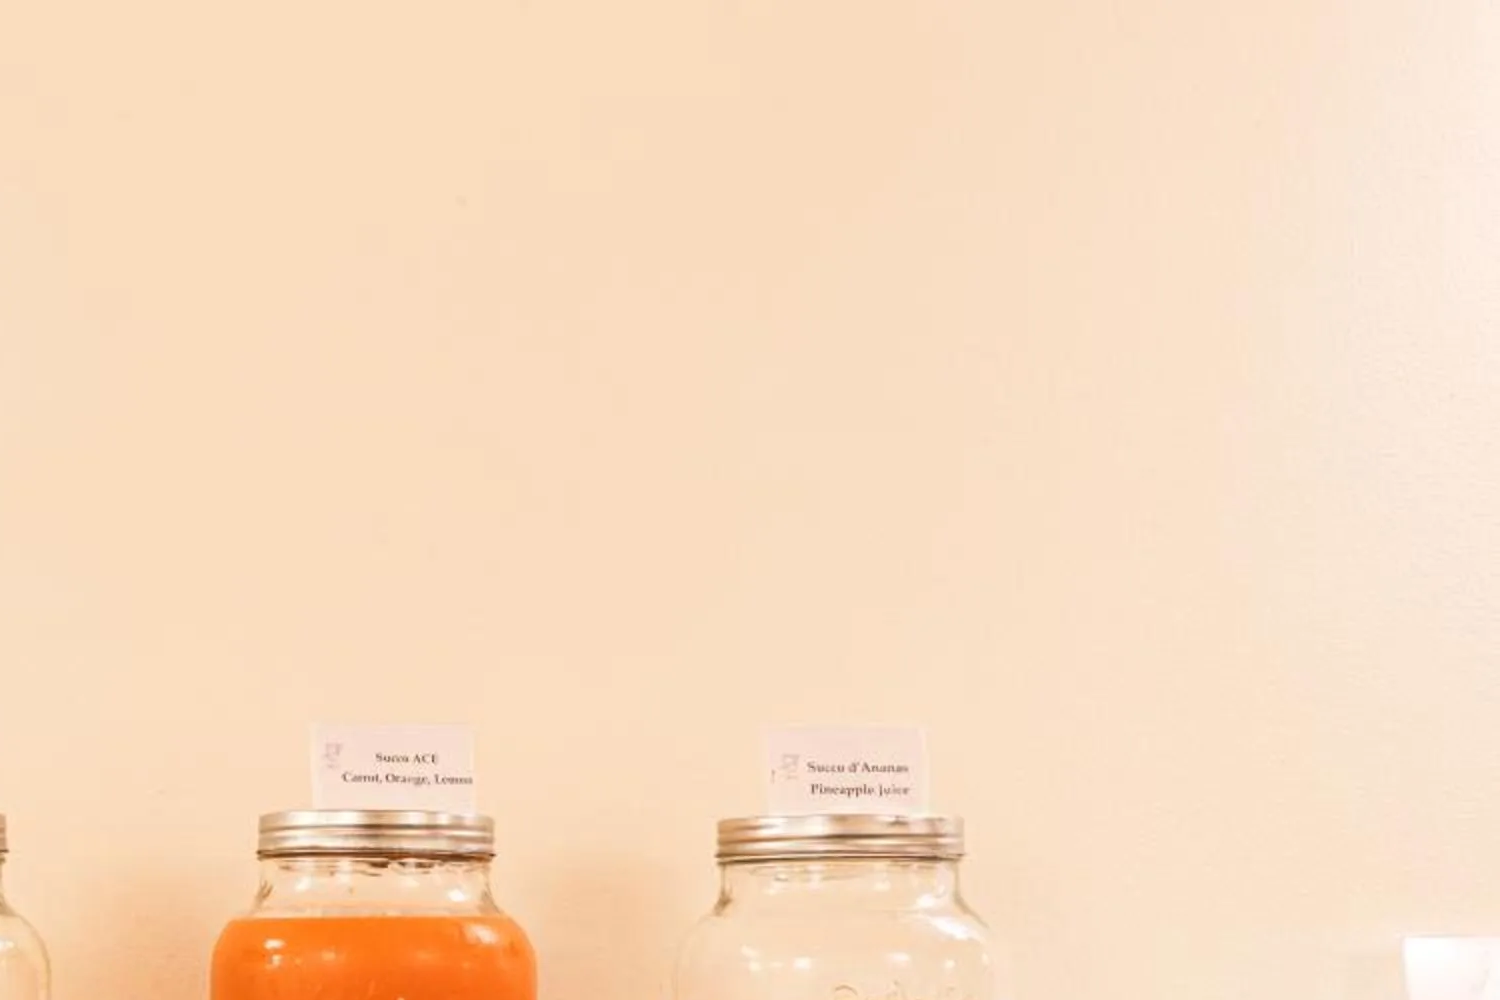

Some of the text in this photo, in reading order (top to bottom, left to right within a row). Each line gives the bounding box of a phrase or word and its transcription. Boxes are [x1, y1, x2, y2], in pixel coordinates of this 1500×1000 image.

[375, 753, 439, 764] Succo ACE
[806, 761, 910, 773] Succo d'Ananas
[810, 783, 910, 797] Pineapple Juice
